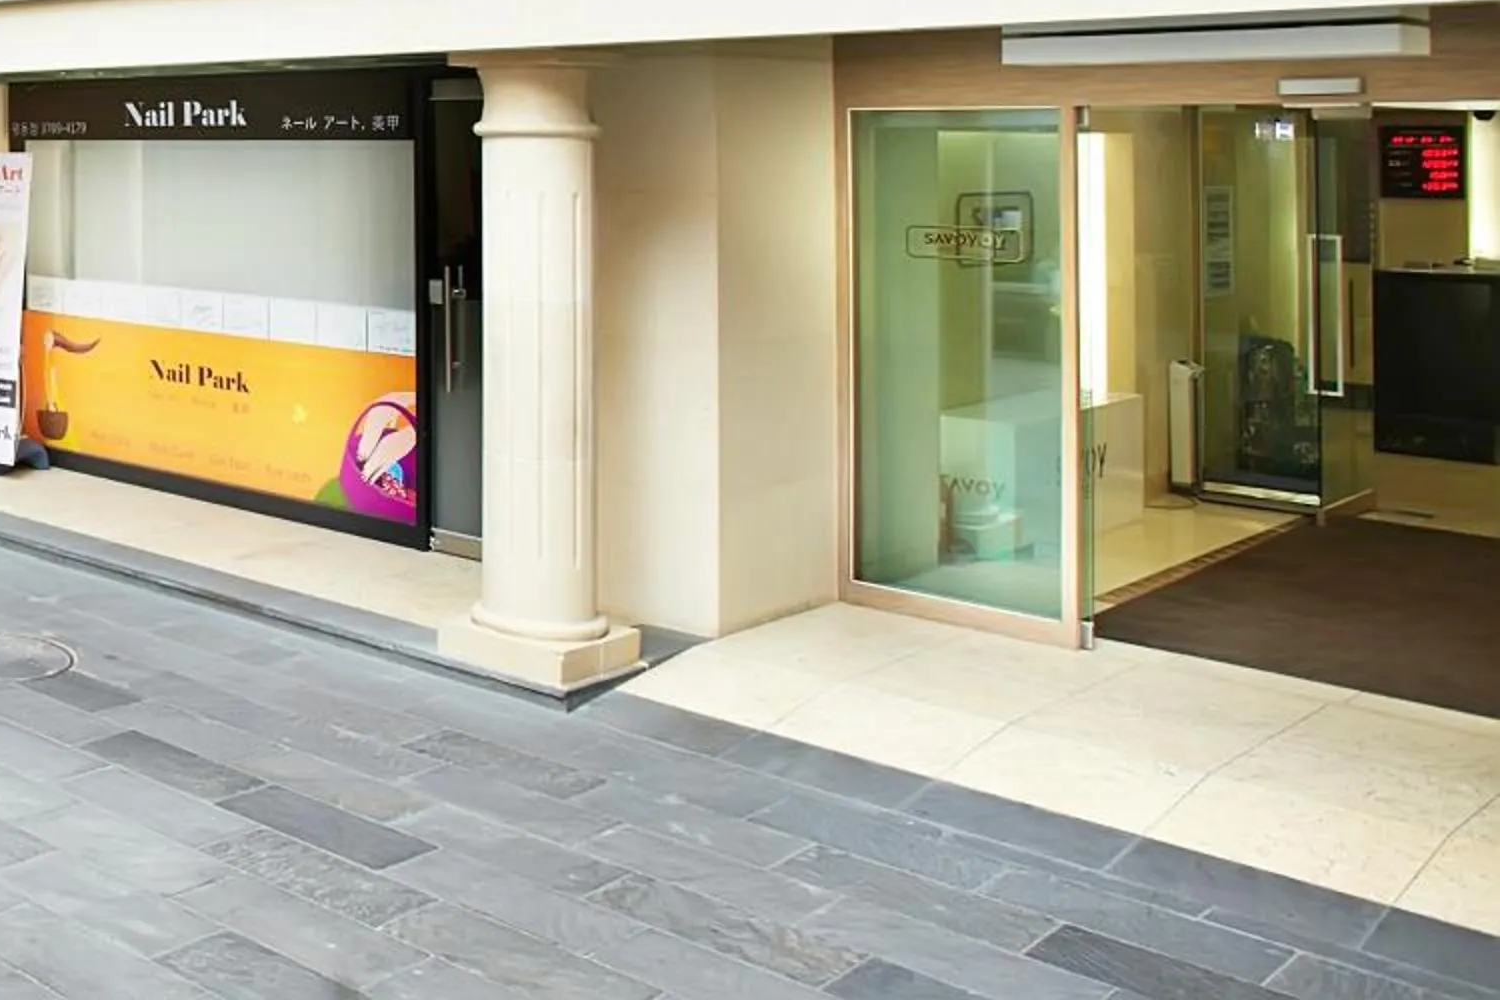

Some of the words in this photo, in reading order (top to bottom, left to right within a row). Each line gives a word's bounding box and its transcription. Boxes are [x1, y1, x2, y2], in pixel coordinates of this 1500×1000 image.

[124, 101, 175, 127] Nail
[183, 100, 247, 127] Park
[0, 164, 23, 181] Art
[151, 360, 191, 385] Nail
[198, 366, 250, 394] Park
